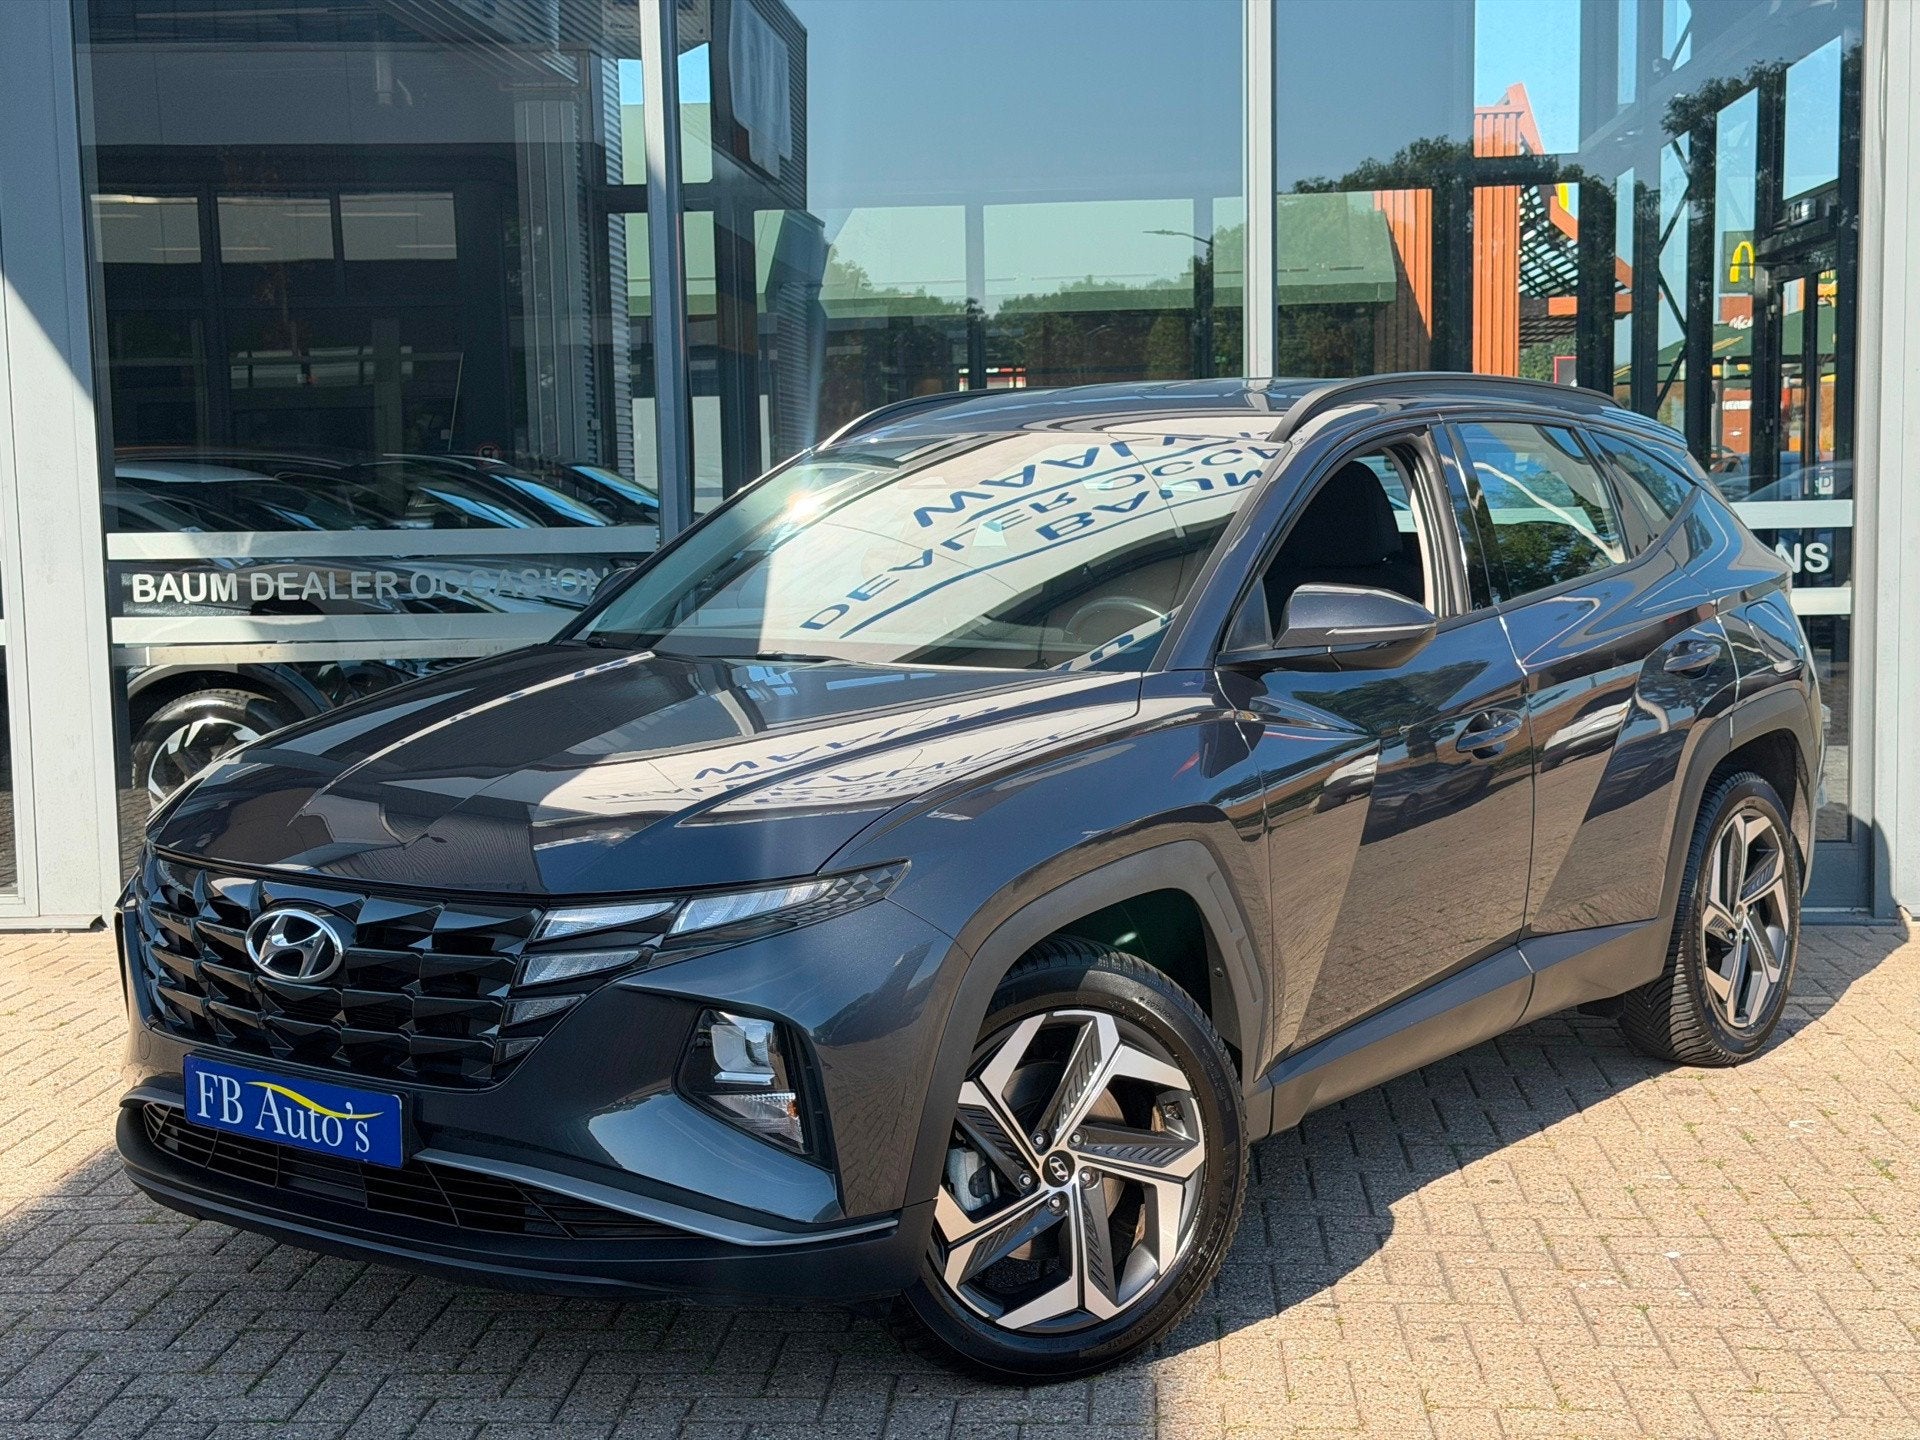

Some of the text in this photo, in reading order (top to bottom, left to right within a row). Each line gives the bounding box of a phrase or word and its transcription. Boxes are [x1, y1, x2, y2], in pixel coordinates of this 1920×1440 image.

[1775, 542, 1830, 573] NS
[132, 572, 239, 603] BAUM
[250, 571, 399, 600] DEALER
[195, 1071, 370, 1154] FB Auto's
